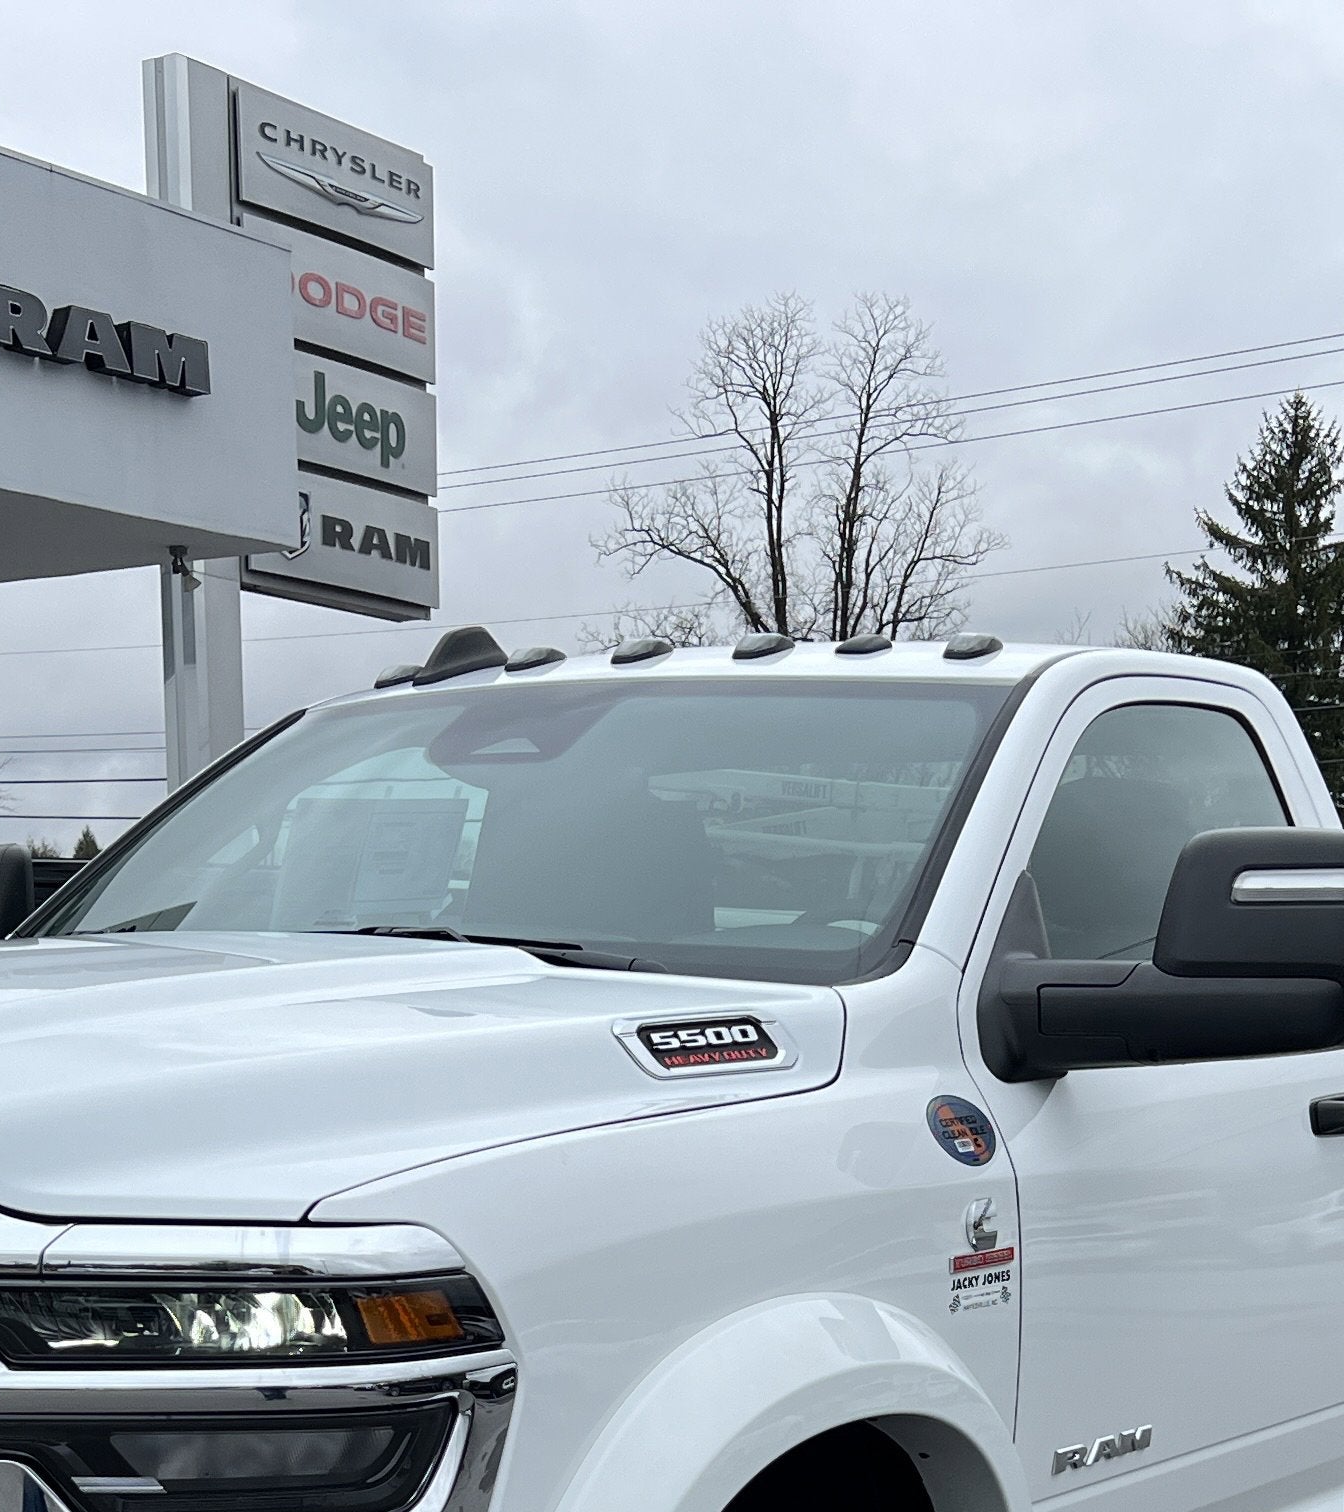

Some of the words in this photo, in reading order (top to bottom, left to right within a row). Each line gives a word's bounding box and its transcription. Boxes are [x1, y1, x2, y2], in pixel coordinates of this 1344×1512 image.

[258, 121, 422, 199] CHRYSLER
[291, 270, 426, 345] ODGE
[295, 370, 406, 468] Jeep
[321, 514, 431, 571] RAM
[649, 1024, 759, 1050] 5500
[664, 1052, 721, 1066] HEAVY
[722, 1048, 768, 1061] DUTY
[951, 1275, 980, 1291] JACKY
[982, 1270, 1011, 1286] JONES
[1051, 1424, 1153, 1476] RAM
